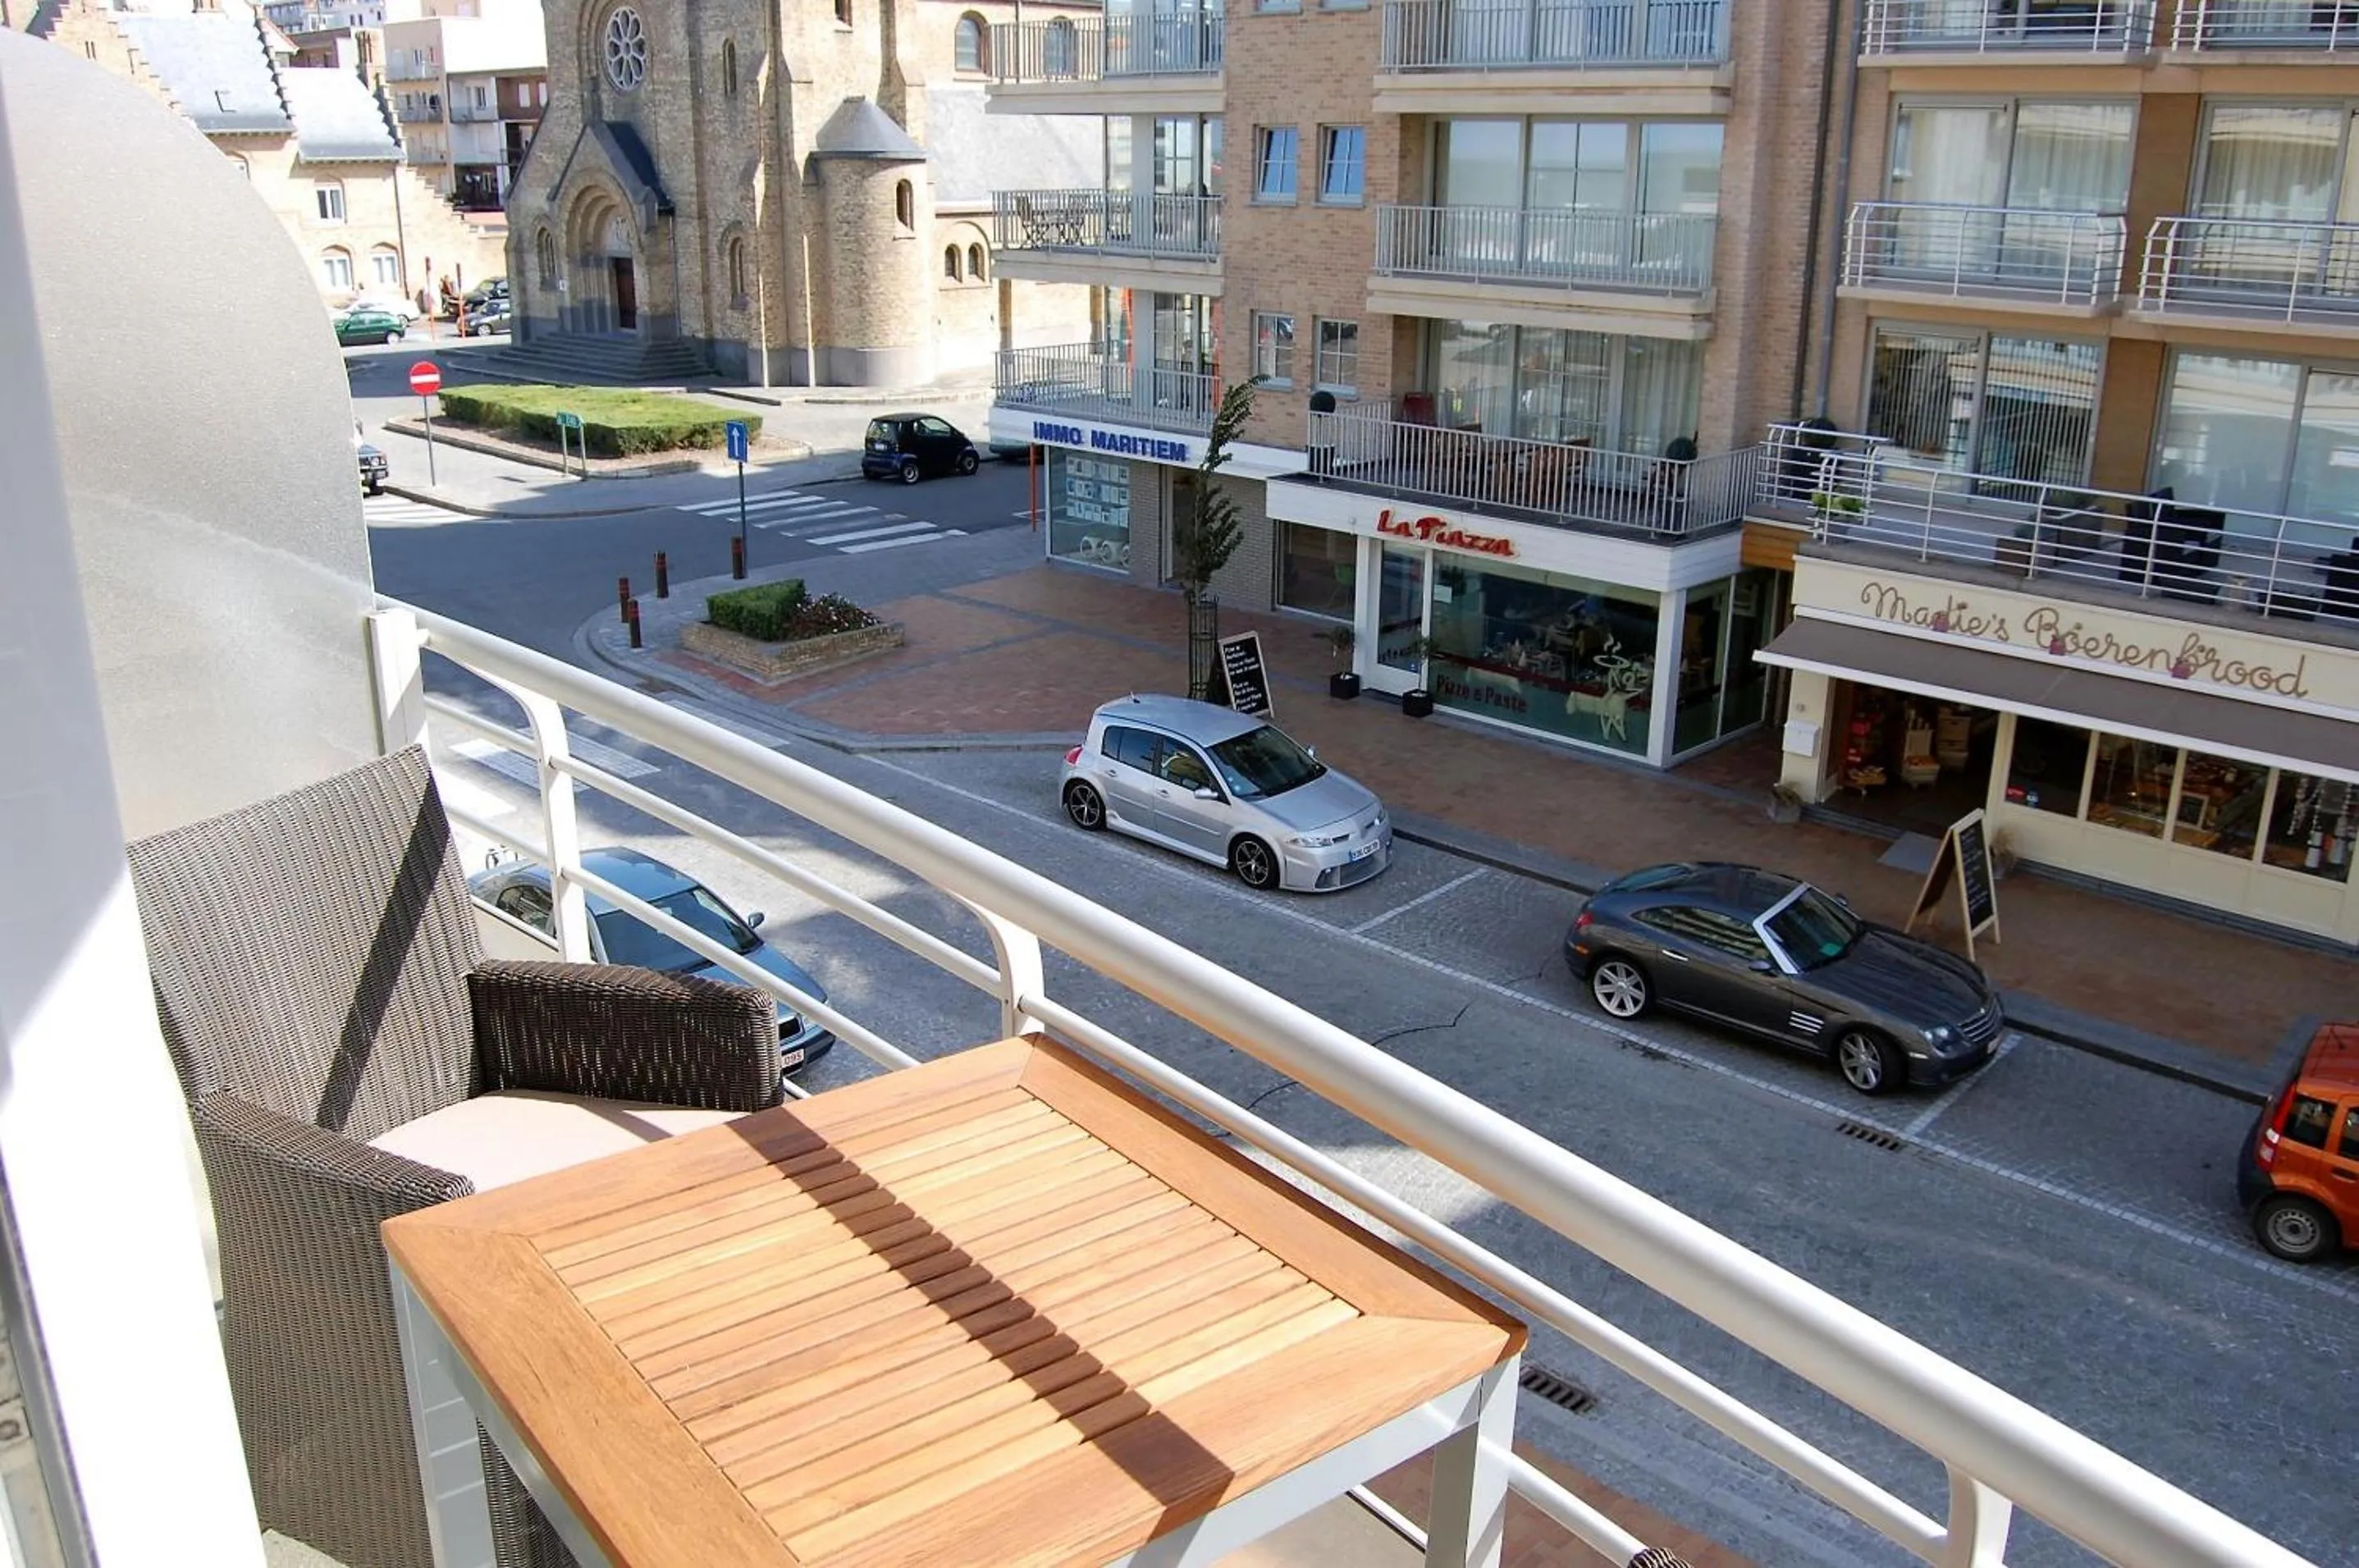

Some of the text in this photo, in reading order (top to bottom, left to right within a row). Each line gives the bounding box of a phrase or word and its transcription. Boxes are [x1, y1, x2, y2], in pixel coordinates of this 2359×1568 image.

[1033, 421, 1186, 461] IMMO MARITIEM
[1377, 510, 1414, 537] La
[1862, 582, 2009, 642] Madie's
